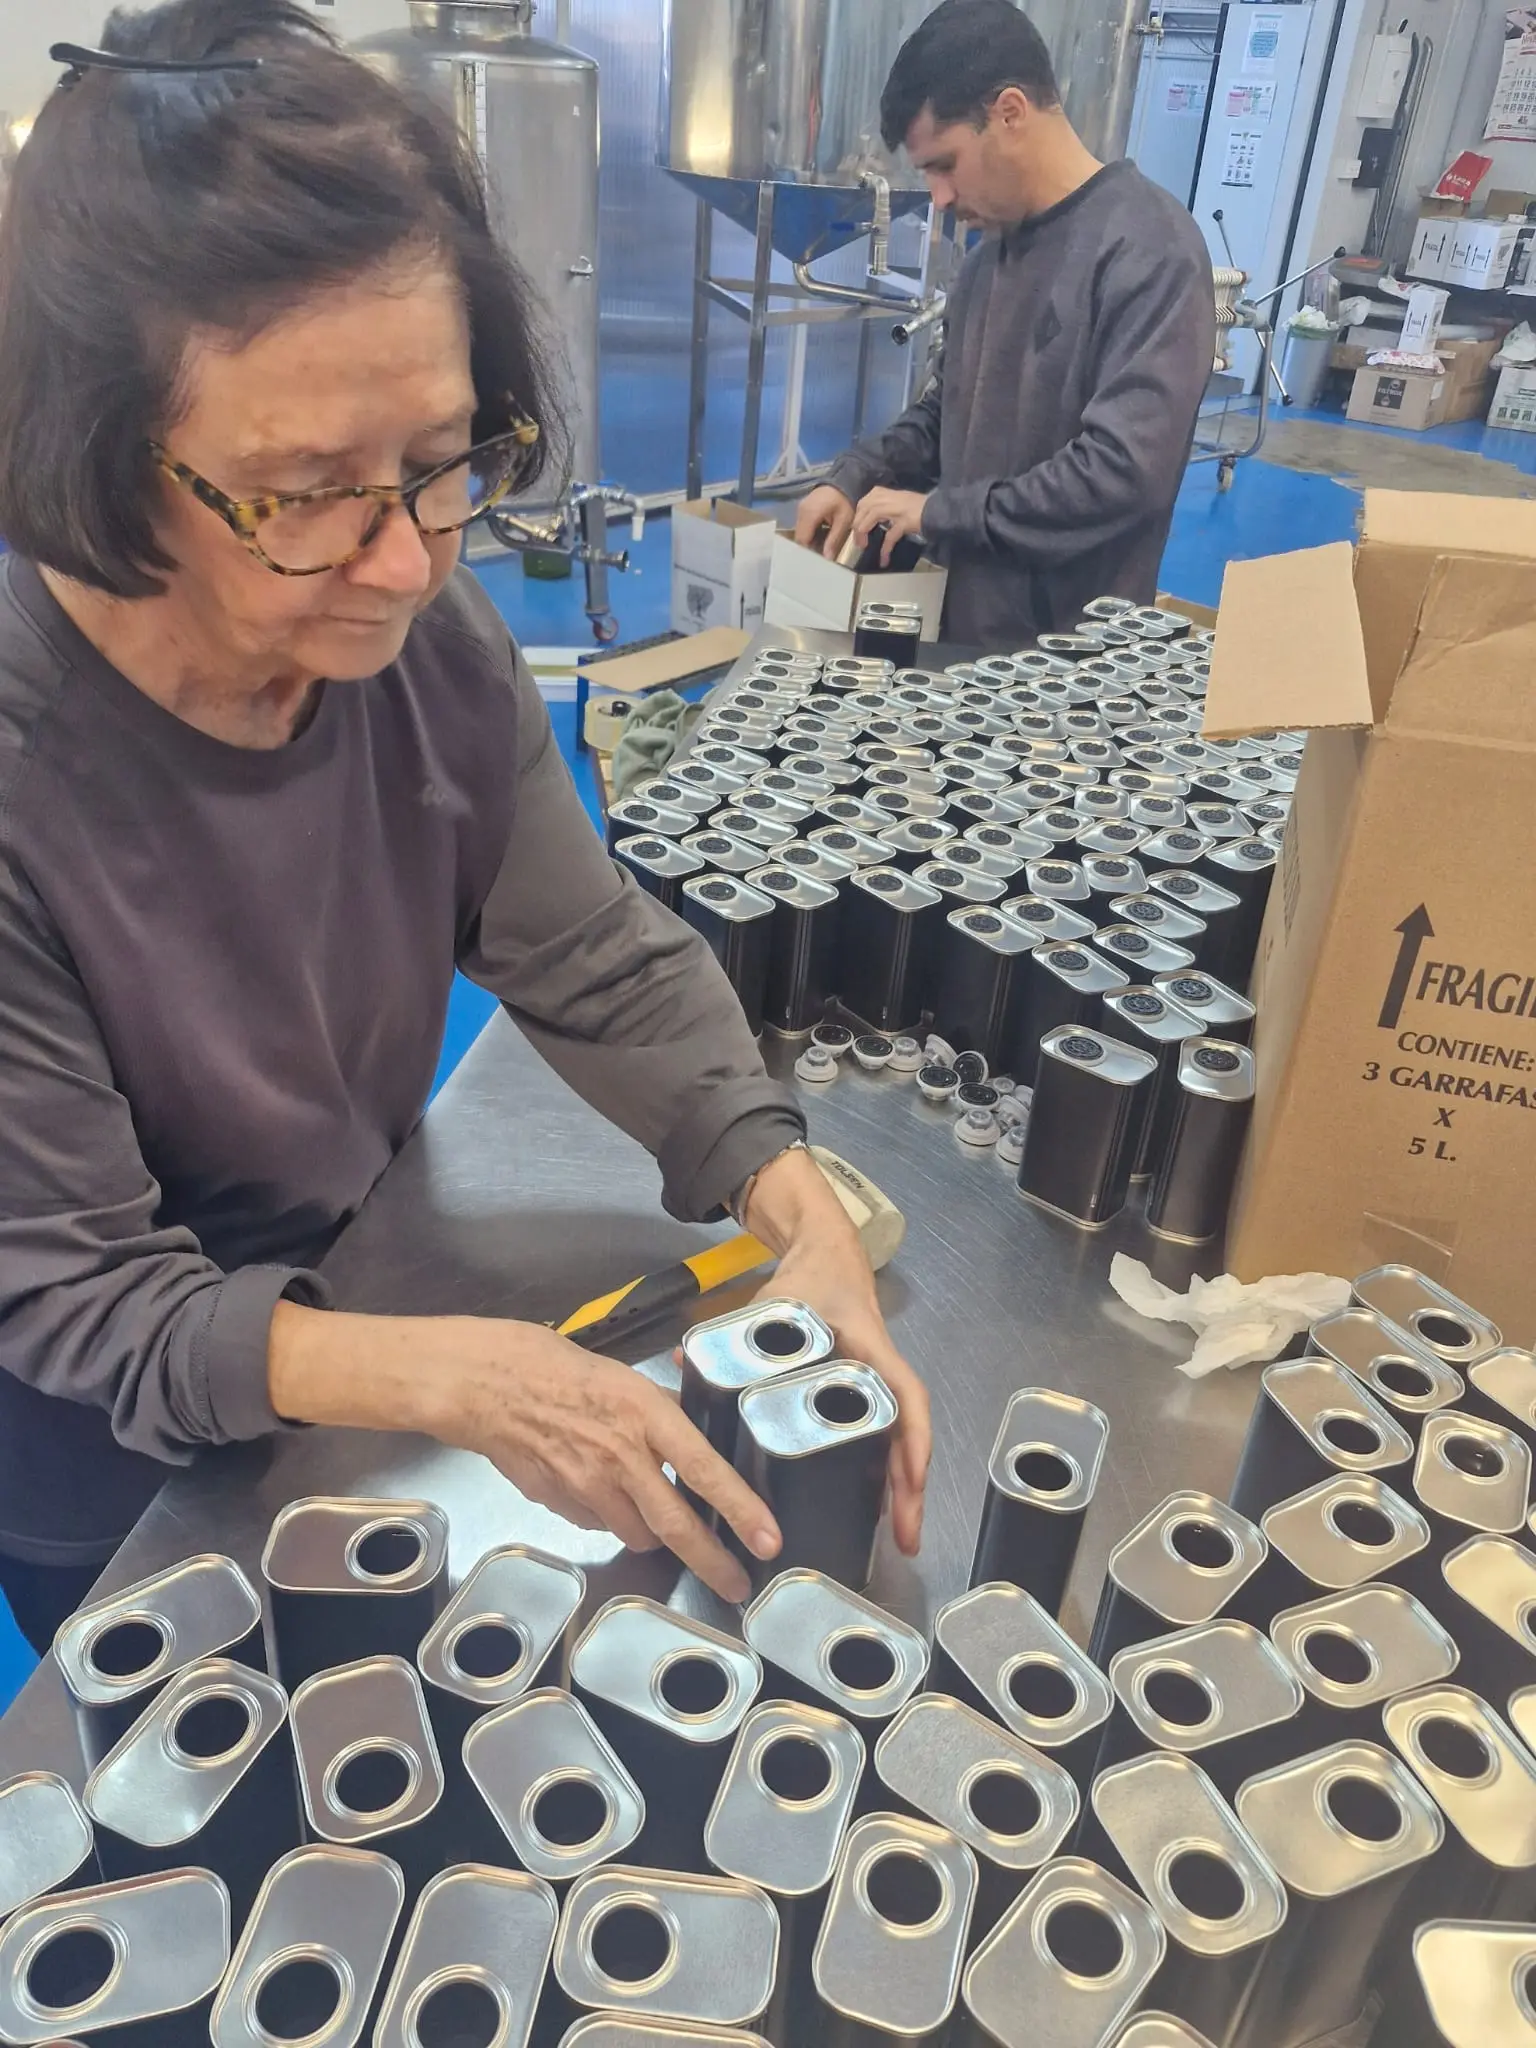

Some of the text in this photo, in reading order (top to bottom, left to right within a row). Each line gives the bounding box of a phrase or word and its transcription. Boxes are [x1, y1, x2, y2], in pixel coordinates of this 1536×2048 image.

[1398, 1031, 1535, 1072] CONTIENE:
[1362, 1061, 1380, 1081] 3
[1408, 1137, 1457, 1162] 5 L.
[831, 1160, 865, 1189] TOLSEN
